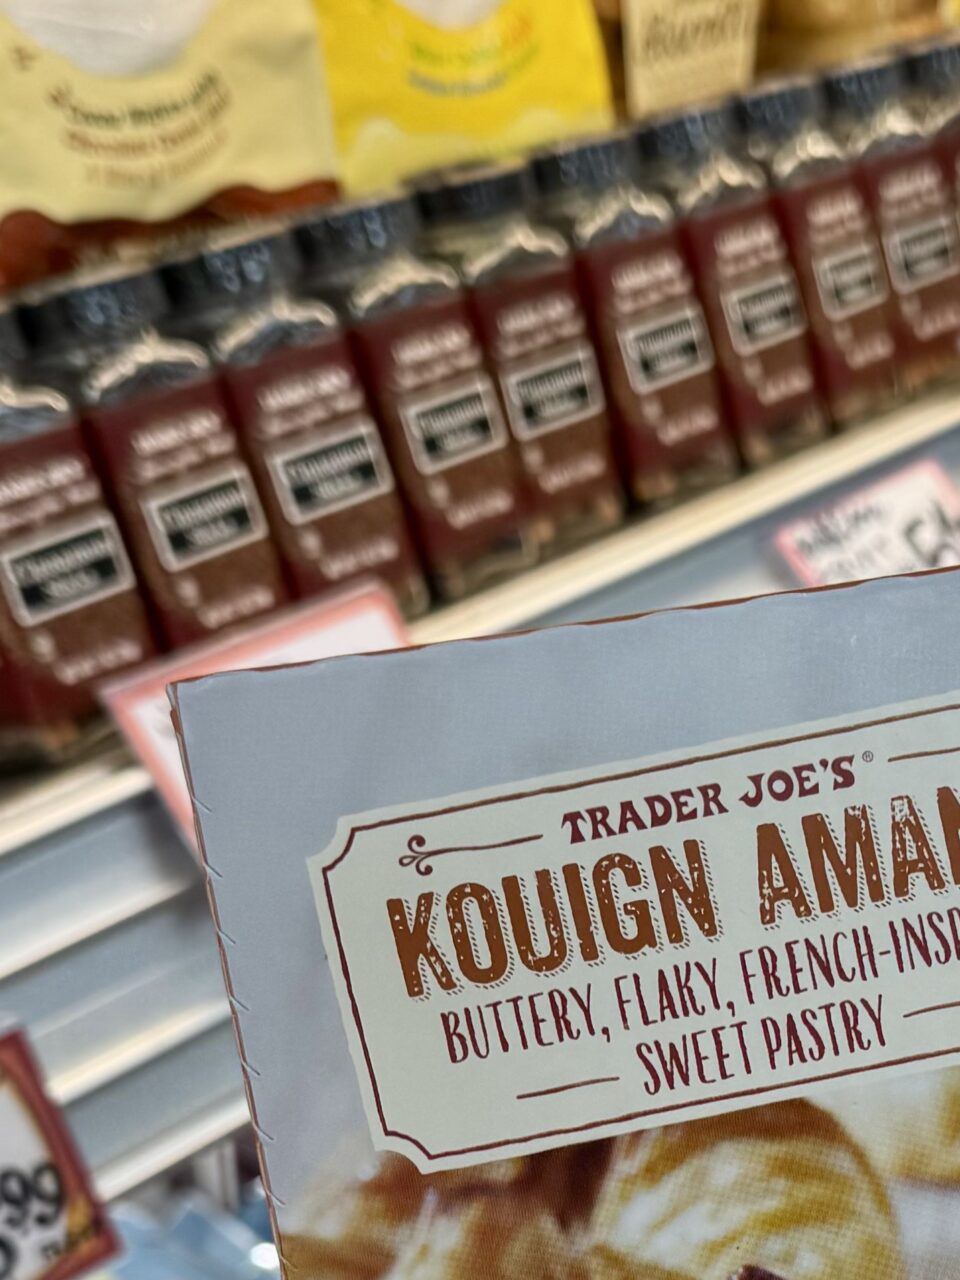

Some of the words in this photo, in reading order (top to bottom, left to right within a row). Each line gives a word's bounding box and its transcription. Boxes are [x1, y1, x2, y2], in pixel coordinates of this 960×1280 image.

[561, 783, 729, 844] TRADER
[739, 755, 855, 808] JOE'S
[386, 838, 724, 1000] KOUIGN
[440, 983, 611, 1064] BUTTERY,
[614, 958, 735, 1031] FLAKY,
[635, 1021, 752, 1095] SWEET
[760, 994, 887, 1071] PASTRY
